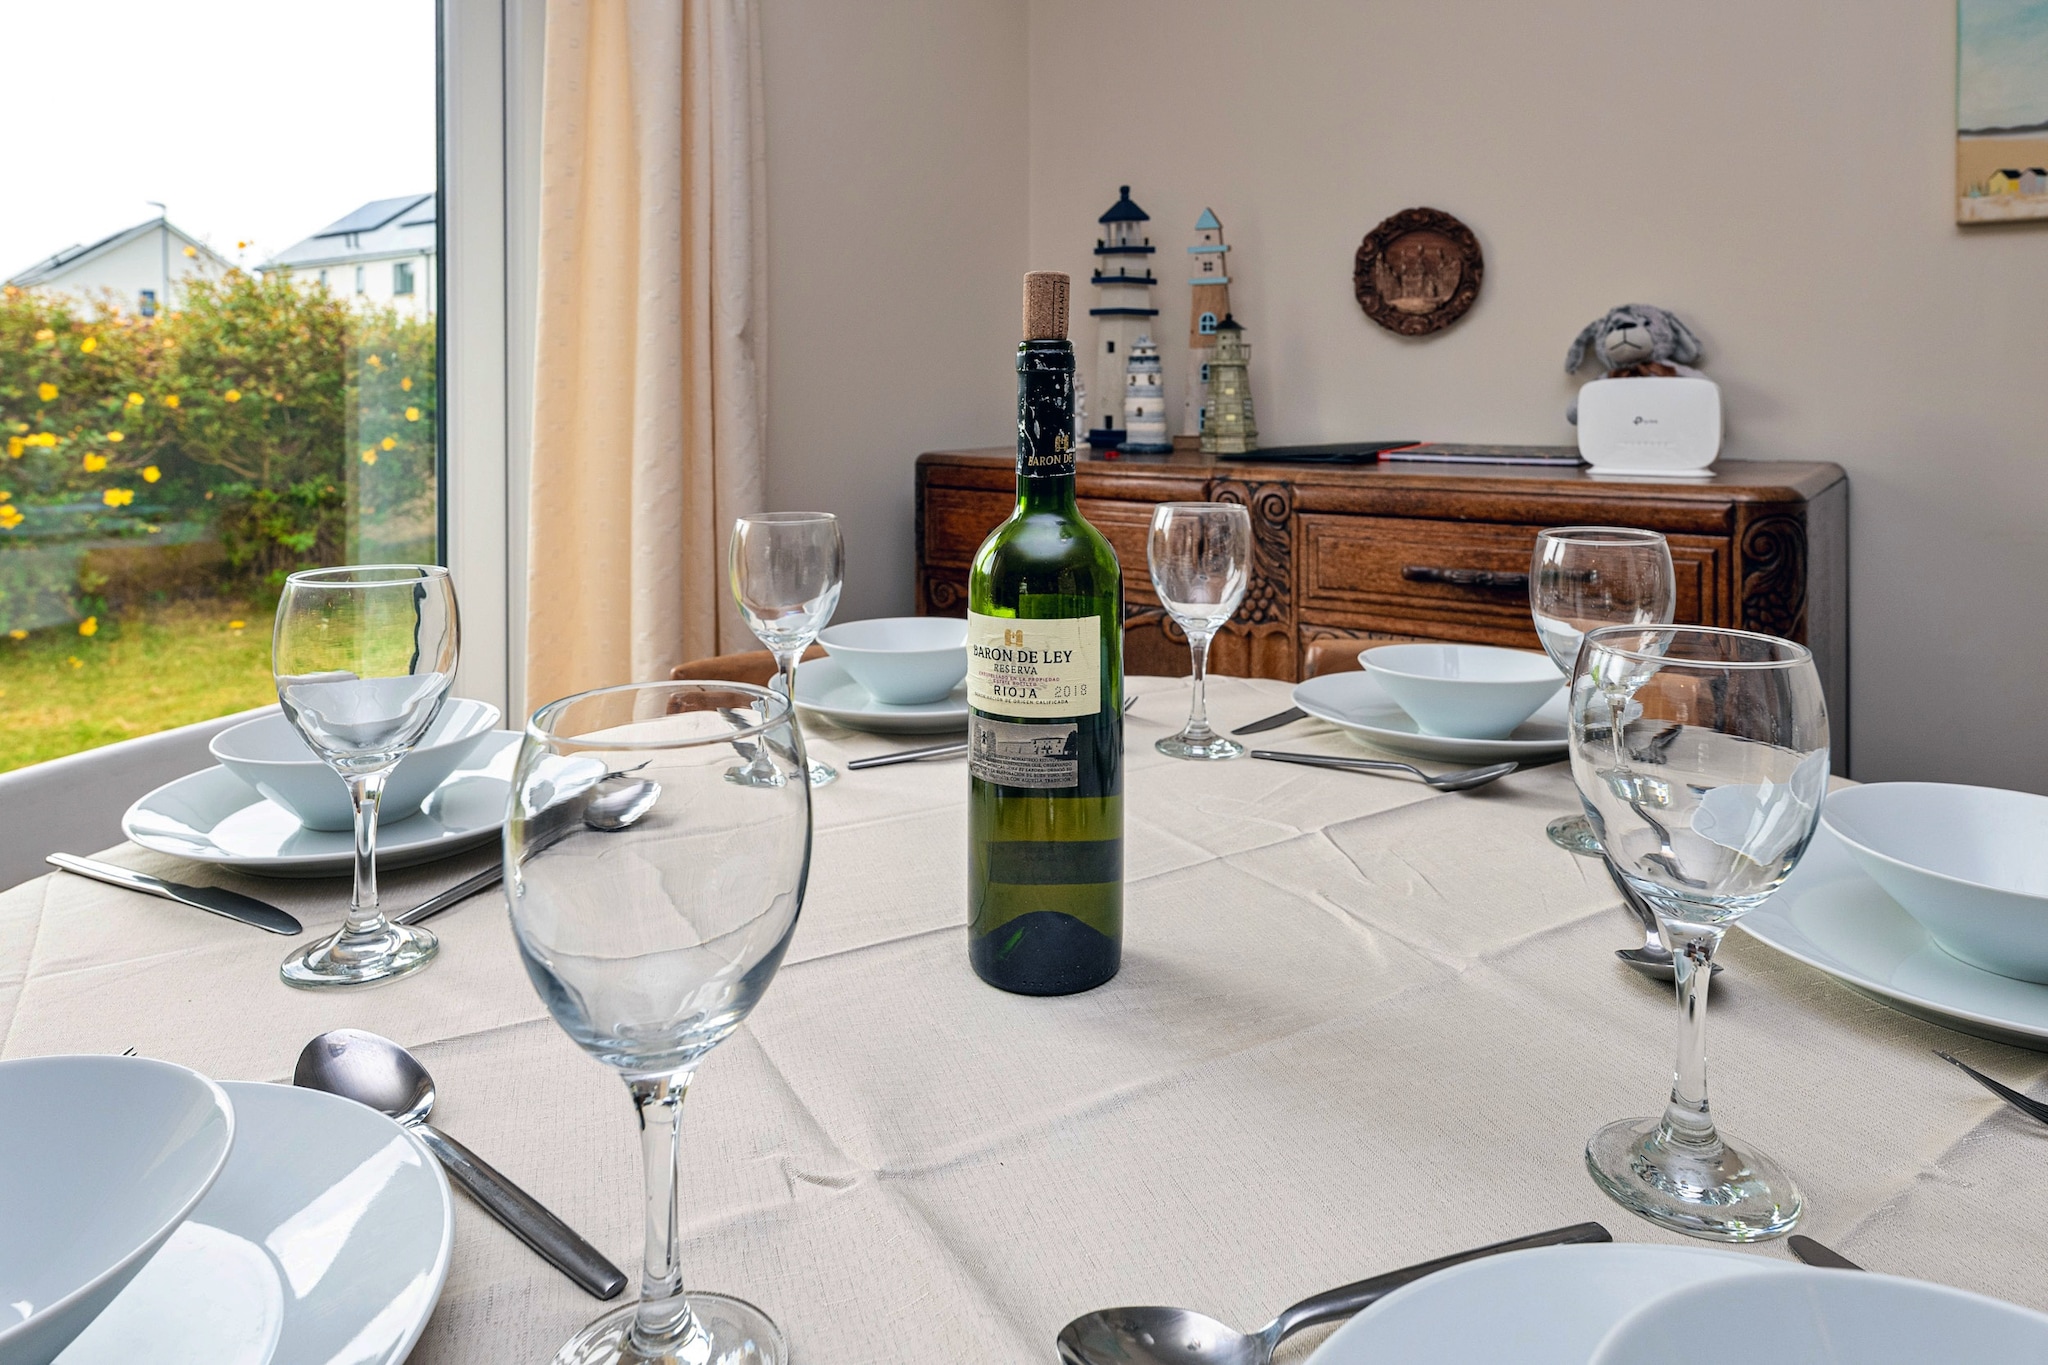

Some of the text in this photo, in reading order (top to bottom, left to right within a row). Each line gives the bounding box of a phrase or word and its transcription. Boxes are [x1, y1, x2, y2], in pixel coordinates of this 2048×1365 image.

[1028, 453, 1073, 466] BARON DE
[973, 644, 1073, 664] BARON DE LEY
[994, 664, 1038, 675] RESERVA
[994, 685, 1038, 699] RIOJA
[1054, 683, 1088, 698] 2018
